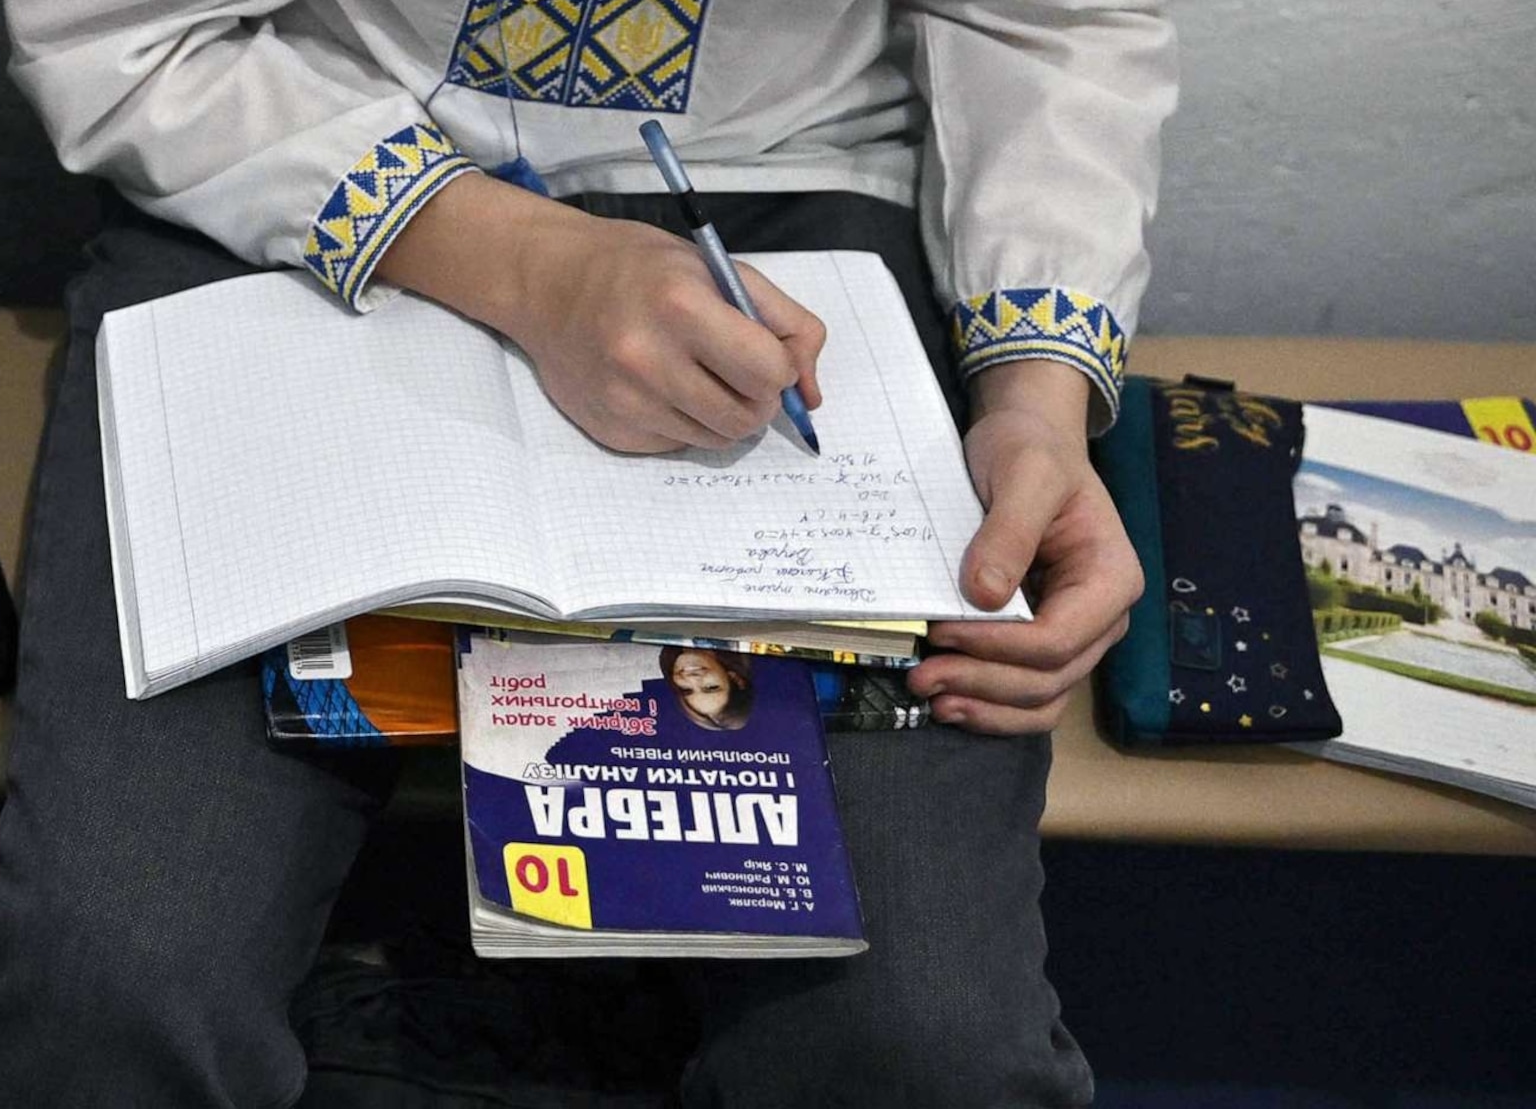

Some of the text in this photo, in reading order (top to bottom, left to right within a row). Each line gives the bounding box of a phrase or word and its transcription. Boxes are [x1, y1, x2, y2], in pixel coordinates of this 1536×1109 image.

[489, 674, 546, 691] робіт
[491, 694, 638, 711] контрольних
[492, 713, 656, 735] Збірник задач
[610, 746, 791, 766] ПРОФІЛЬНИЙ РІВЕНЬ
[521, 763, 638, 781] АНАЛІЗУ
[647, 767, 778, 788] ПОЧАТКИ
[523, 785, 798, 846] АЛГЕБРА
[744, 860, 772, 871] Якір
[515, 855, 579, 896] 10
[705, 872, 771, 884] Рабінович
[701, 884, 780, 897] Полонський
[728, 898, 786, 910] Мерзляк
